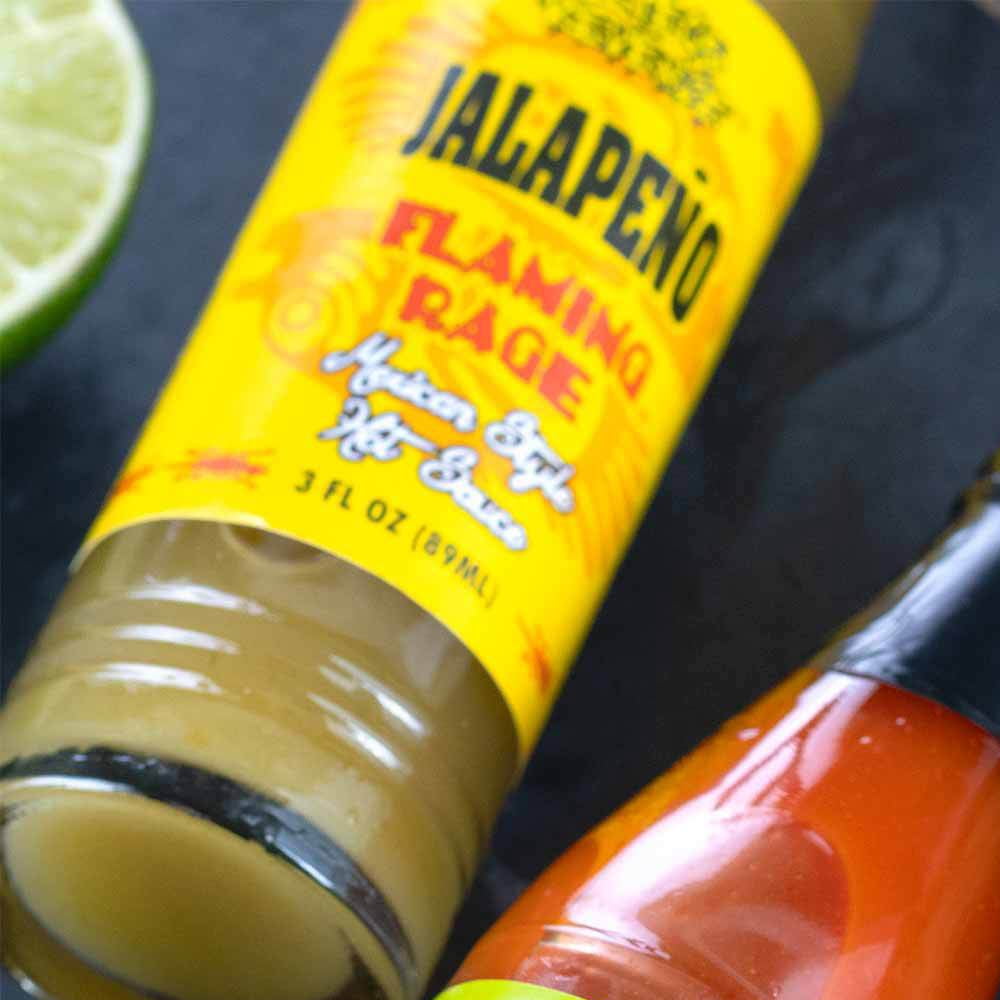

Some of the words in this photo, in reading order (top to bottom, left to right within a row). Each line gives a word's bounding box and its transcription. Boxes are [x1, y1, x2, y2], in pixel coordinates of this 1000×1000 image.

[380, 199, 653, 400] FLAMING
[399, 273, 592, 421] RAGE
[316, 395, 441, 461] Hot
[419, 445, 528, 551] Sauce
[320, 331, 477, 432] Mexican
[484, 409, 576, 514] Style
[295, 470, 316, 493] 3
[323, 479, 354, 510] FL
[365, 499, 408, 533] OZ
[411, 526, 499, 608] (89ML)
